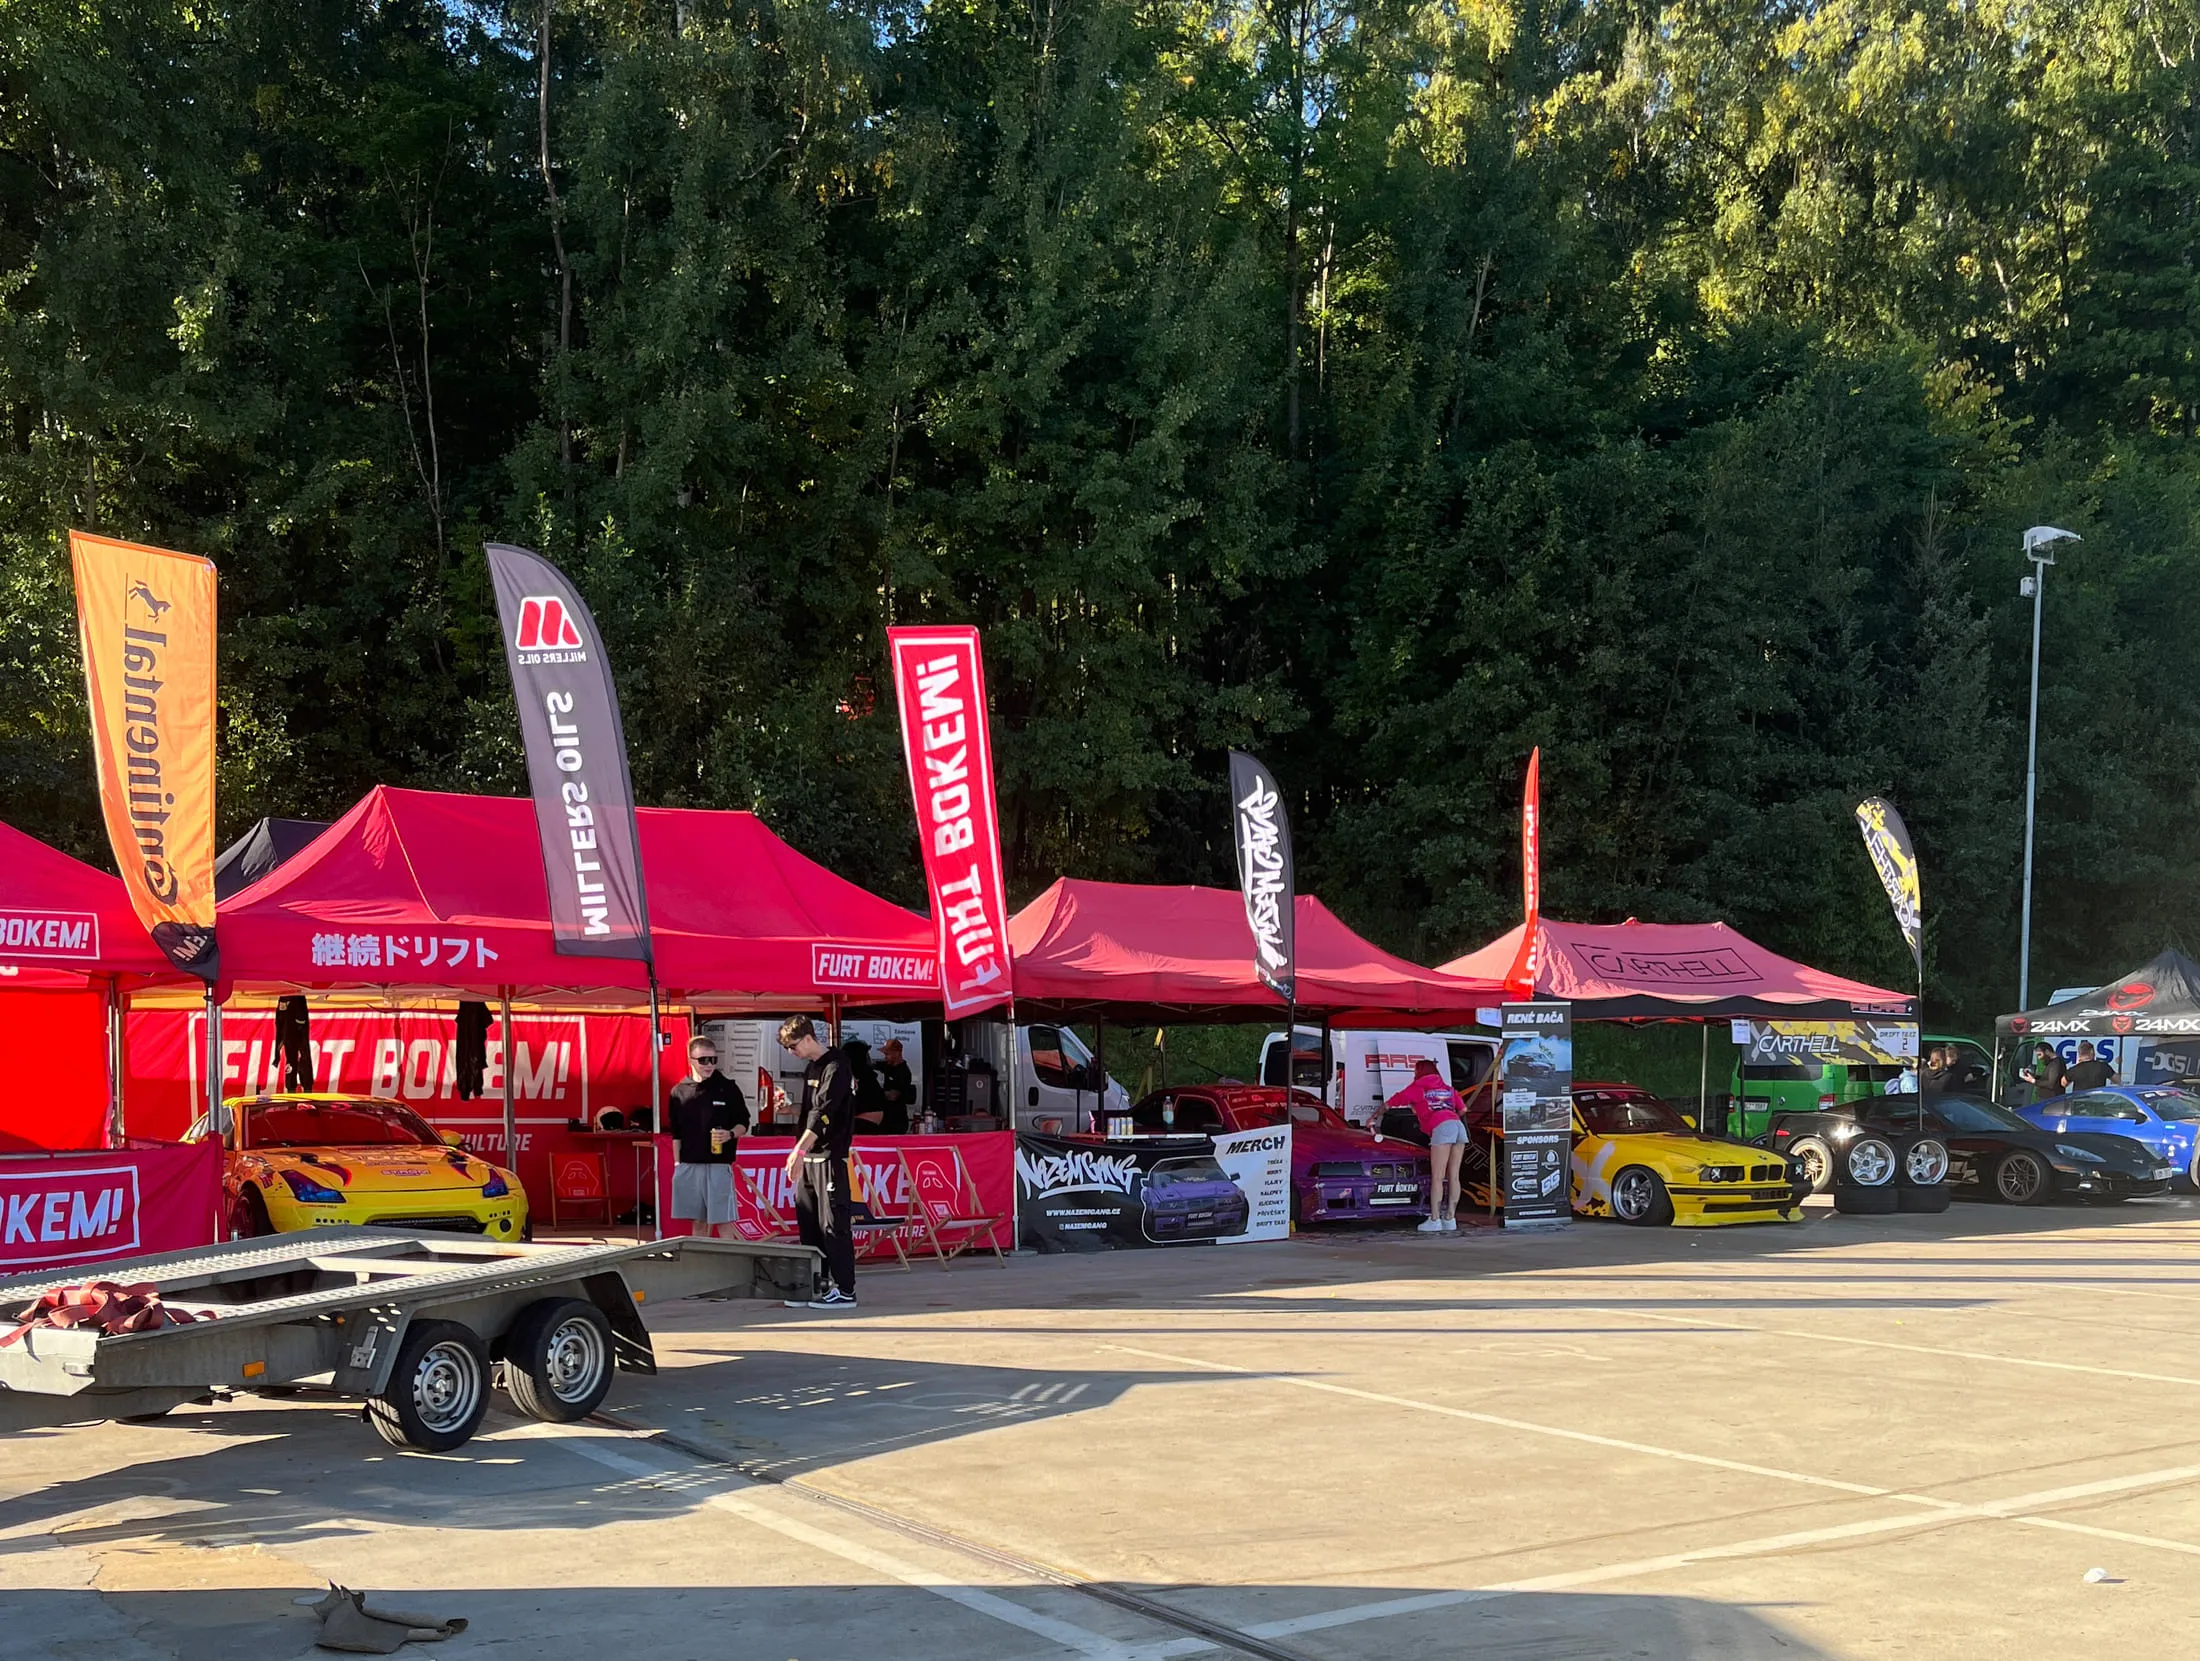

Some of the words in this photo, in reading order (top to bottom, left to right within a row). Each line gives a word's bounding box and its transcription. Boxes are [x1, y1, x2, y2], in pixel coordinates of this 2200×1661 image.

[311, 932, 499, 968] 継続ドリフト
[818, 952, 865, 978] FURT
[867, 955, 936, 981] BOKEM!
[1591, 954, 1747, 978] CARTHELL
[2030, 1019, 2091, 1033] 24MX
[2134, 1018, 2200, 1032] 24MX
[1758, 1035, 1840, 1053] CARTHELL
[1902, 1037, 1908, 1051] 2
[2055, 1039, 2115, 1065] GS
[221, 1039, 356, 1097] FUT
[1225, 1135, 1286, 1154] MERCH
[1516, 1134, 1560, 1145] SPONSORS
[0, 1187, 124, 1244] KEM!
